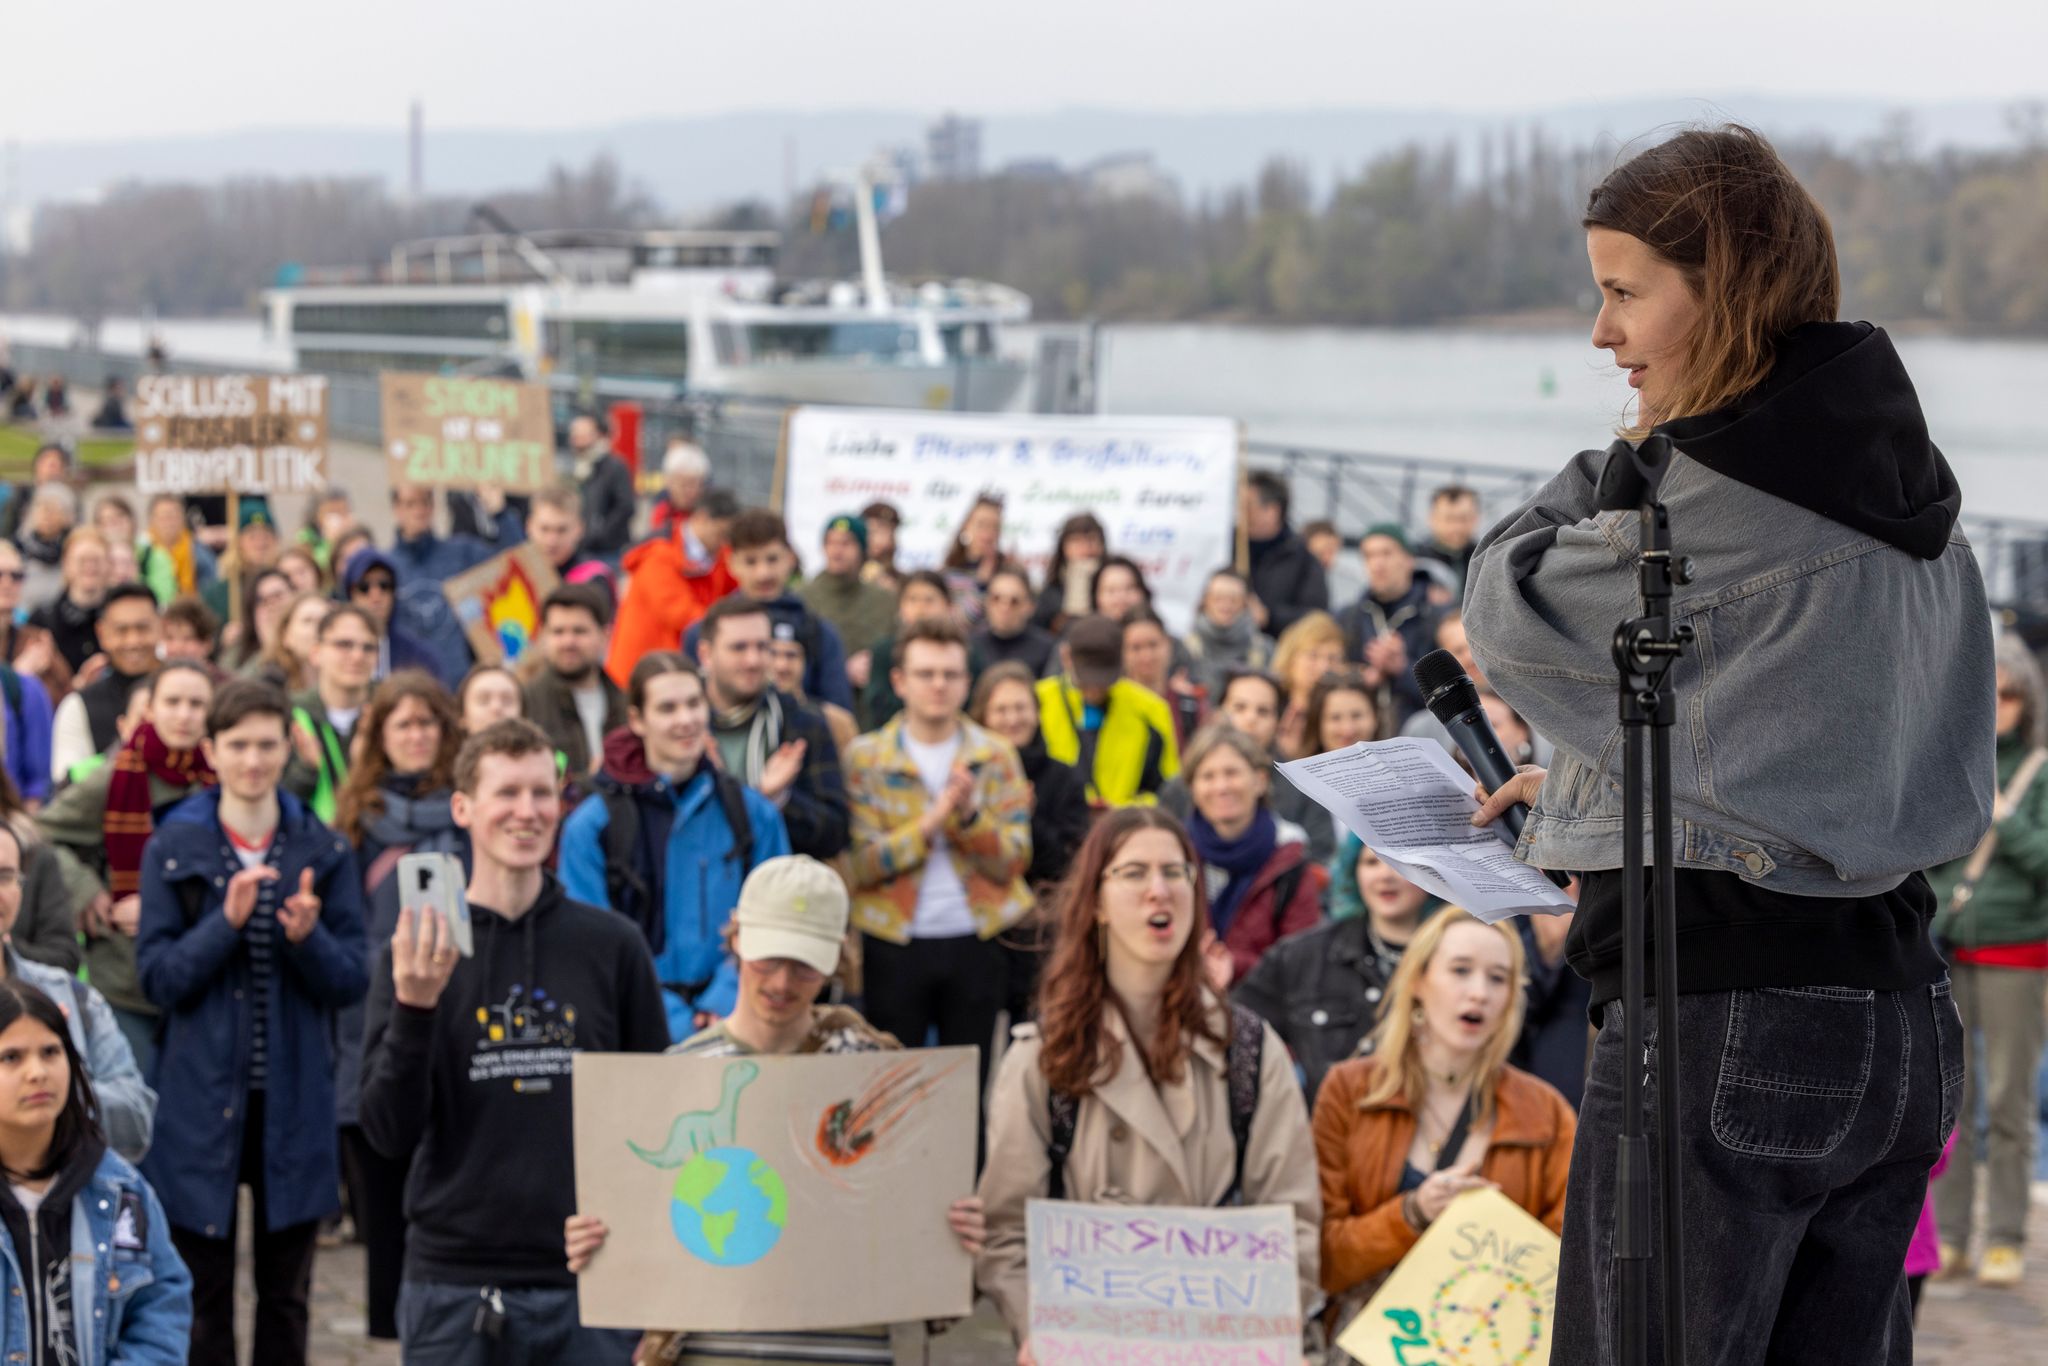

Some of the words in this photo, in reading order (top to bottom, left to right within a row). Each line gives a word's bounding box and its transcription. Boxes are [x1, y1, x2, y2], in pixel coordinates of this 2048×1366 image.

[269, 375, 328, 415] MIT
[407, 434, 546, 487] ZUKUNFT
[1046, 1216, 1123, 1258] WIR
[1126, 1219, 1240, 1257] SIND
[1450, 1221, 1543, 1272] SAVE
[1050, 1262, 1257, 1309] REGEN
